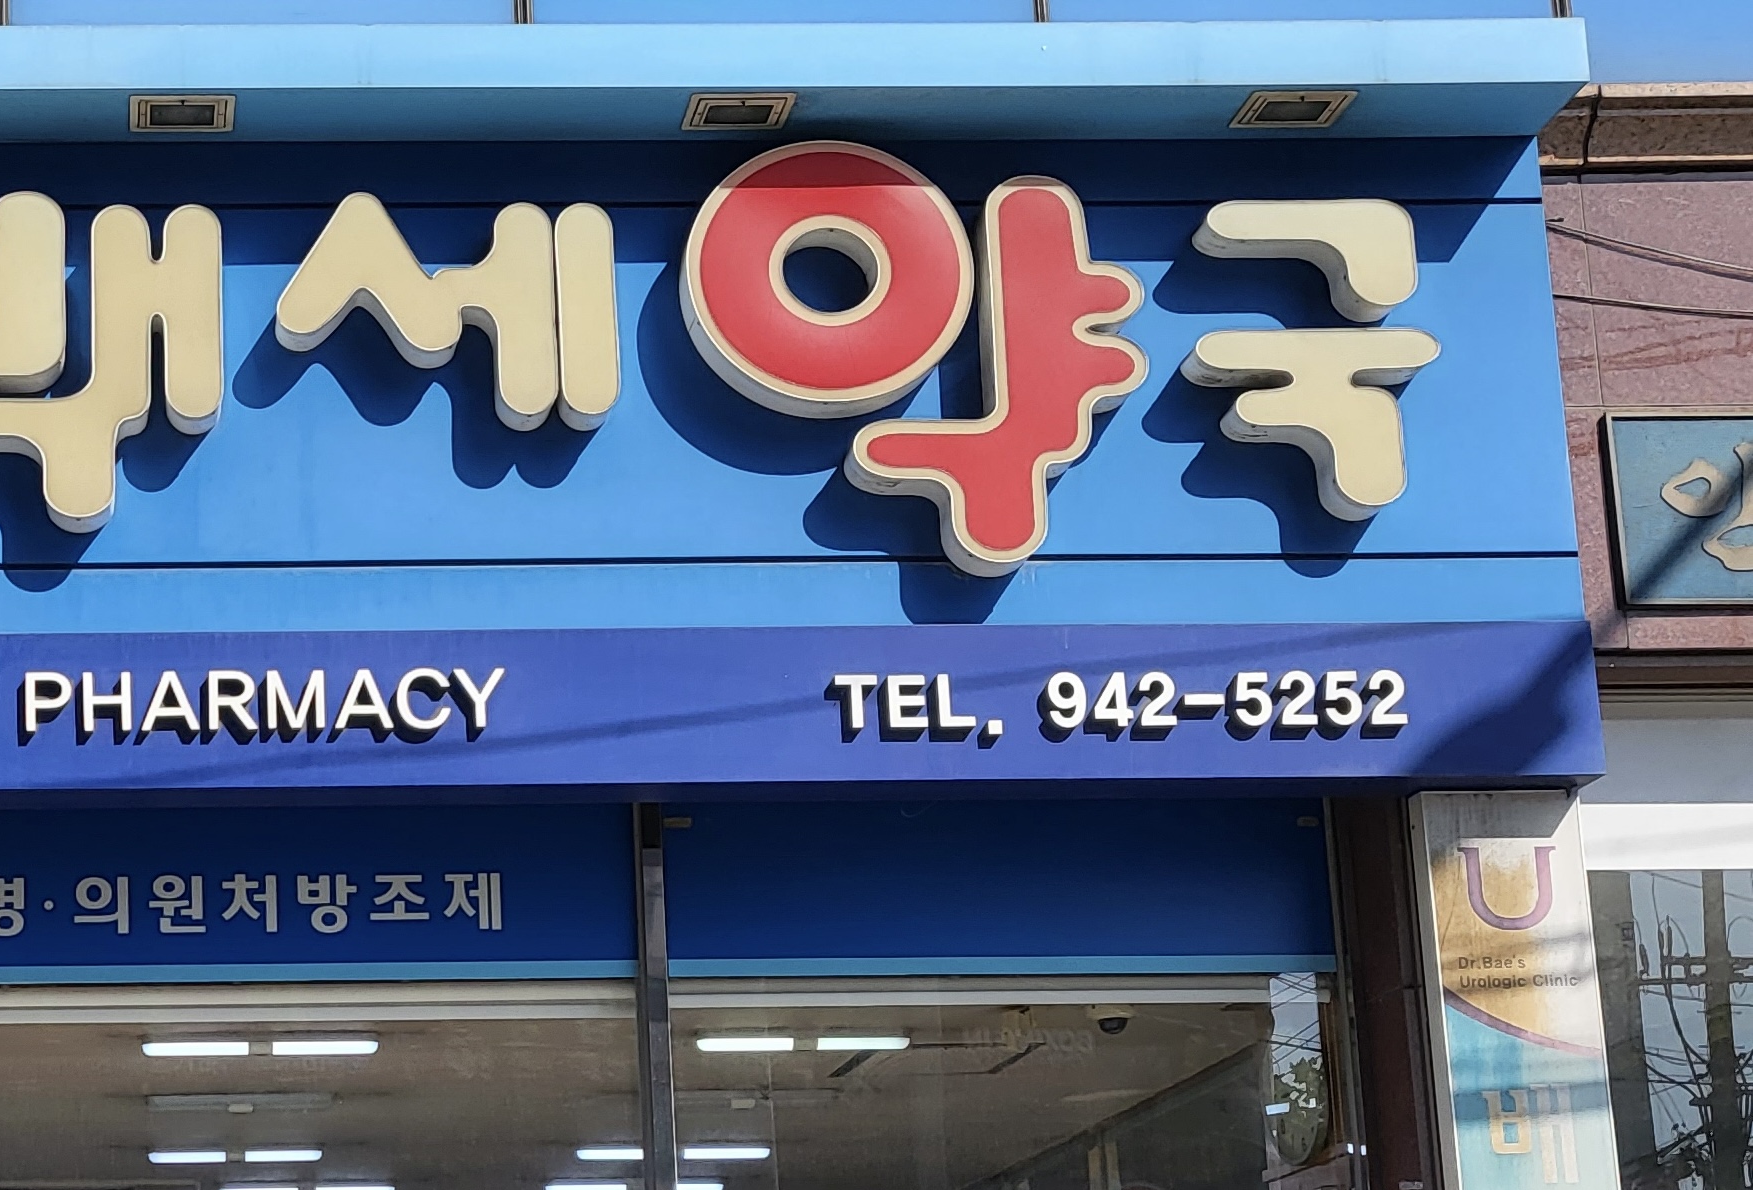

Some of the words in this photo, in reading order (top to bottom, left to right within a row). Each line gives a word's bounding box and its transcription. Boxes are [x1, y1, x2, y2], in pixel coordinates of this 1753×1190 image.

[19, 667, 506, 740] PHARMACY
[1048, 668, 1410, 730] 942-5252
[1458, 954, 1526, 970] Dr.Bae's
[1459, 974, 1527, 989] Urologic
[1532, 973, 1579, 987] Clinic
